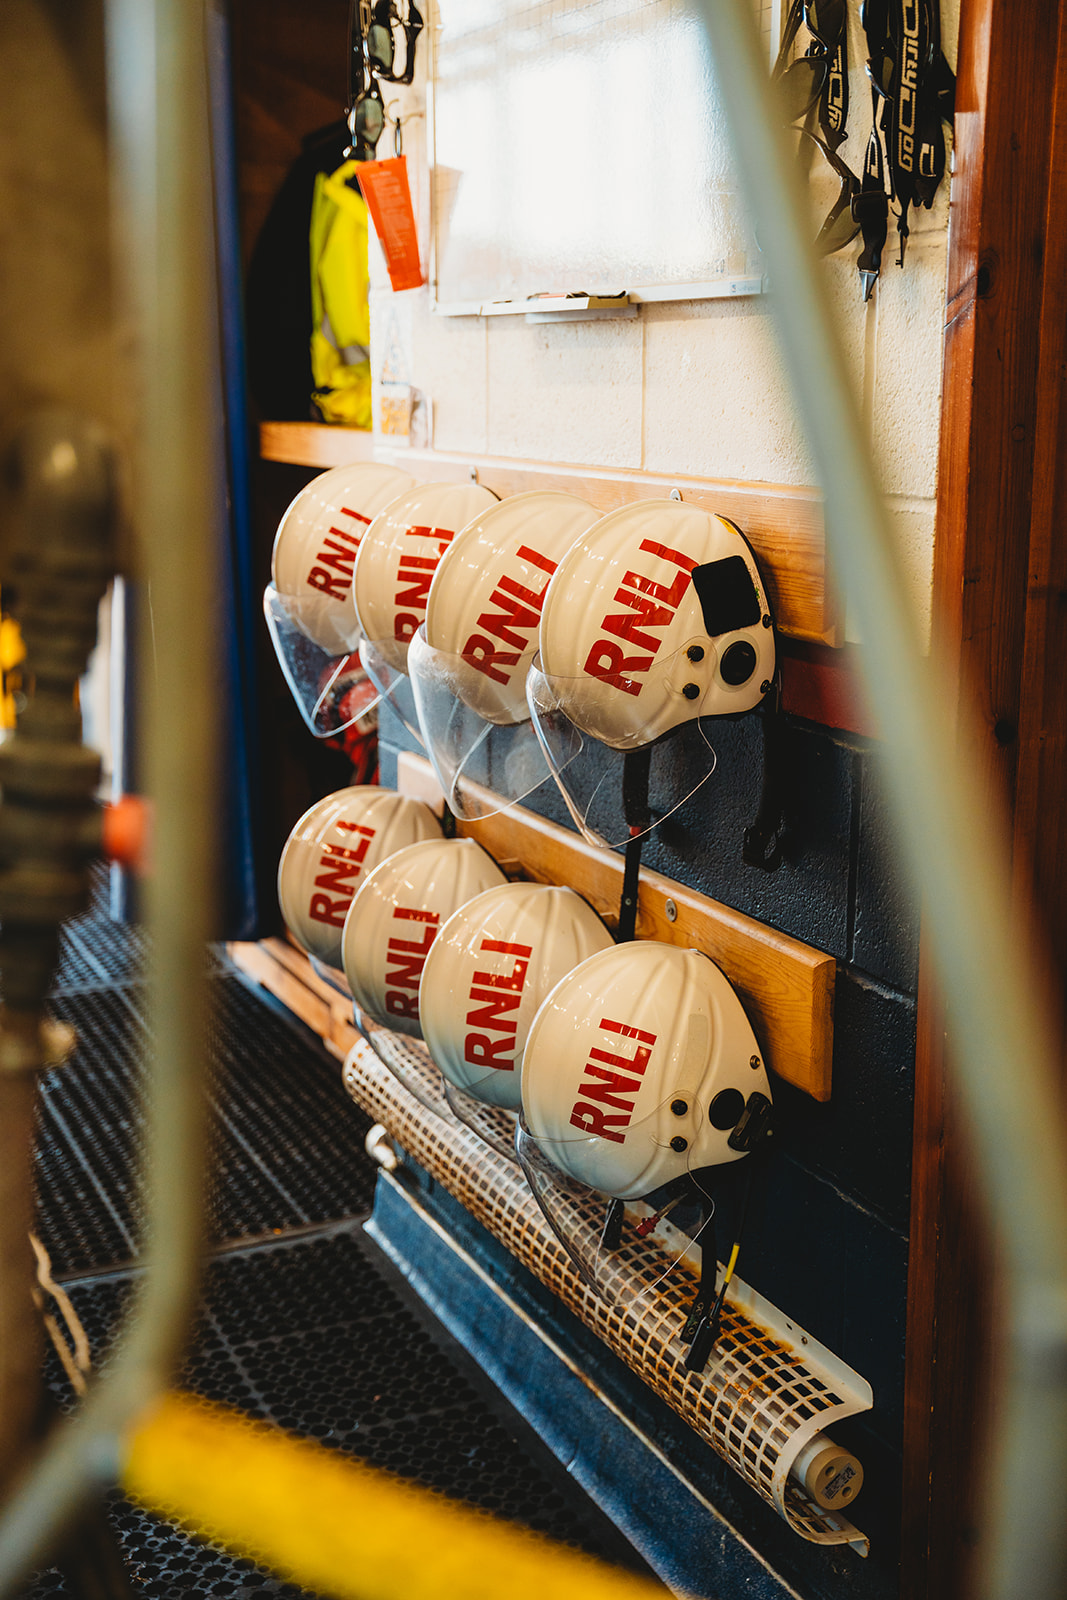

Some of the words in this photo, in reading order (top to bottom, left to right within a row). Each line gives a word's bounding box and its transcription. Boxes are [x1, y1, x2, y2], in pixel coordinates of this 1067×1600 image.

[306, 507, 373, 602] RNLI
[393, 526, 455, 644] RNLI
[460, 544, 559, 686] RNLI
[583, 538, 700, 697] RNLI
[308, 820, 376, 929] RNLI
[384, 907, 440, 1020] RNLI
[464, 938, 533, 1072] RNLI
[569, 1017, 658, 1144] RNLI
